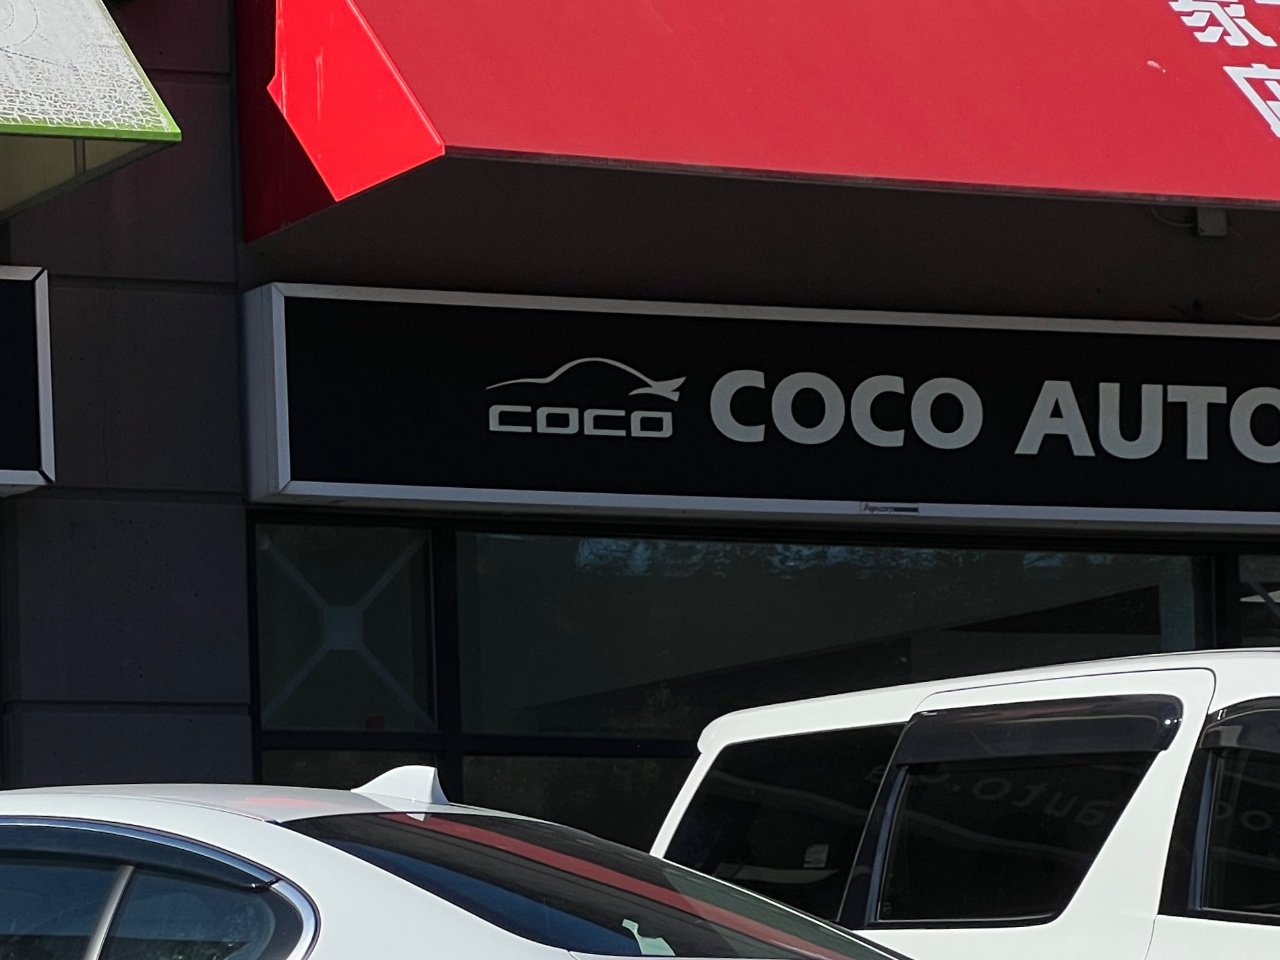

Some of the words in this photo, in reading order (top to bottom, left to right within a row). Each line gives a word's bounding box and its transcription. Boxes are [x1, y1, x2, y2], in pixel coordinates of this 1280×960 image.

[488, 404, 673, 438] COCO
[709, 368, 984, 450] COCO
[1014, 380, 1280, 464] AUTO
